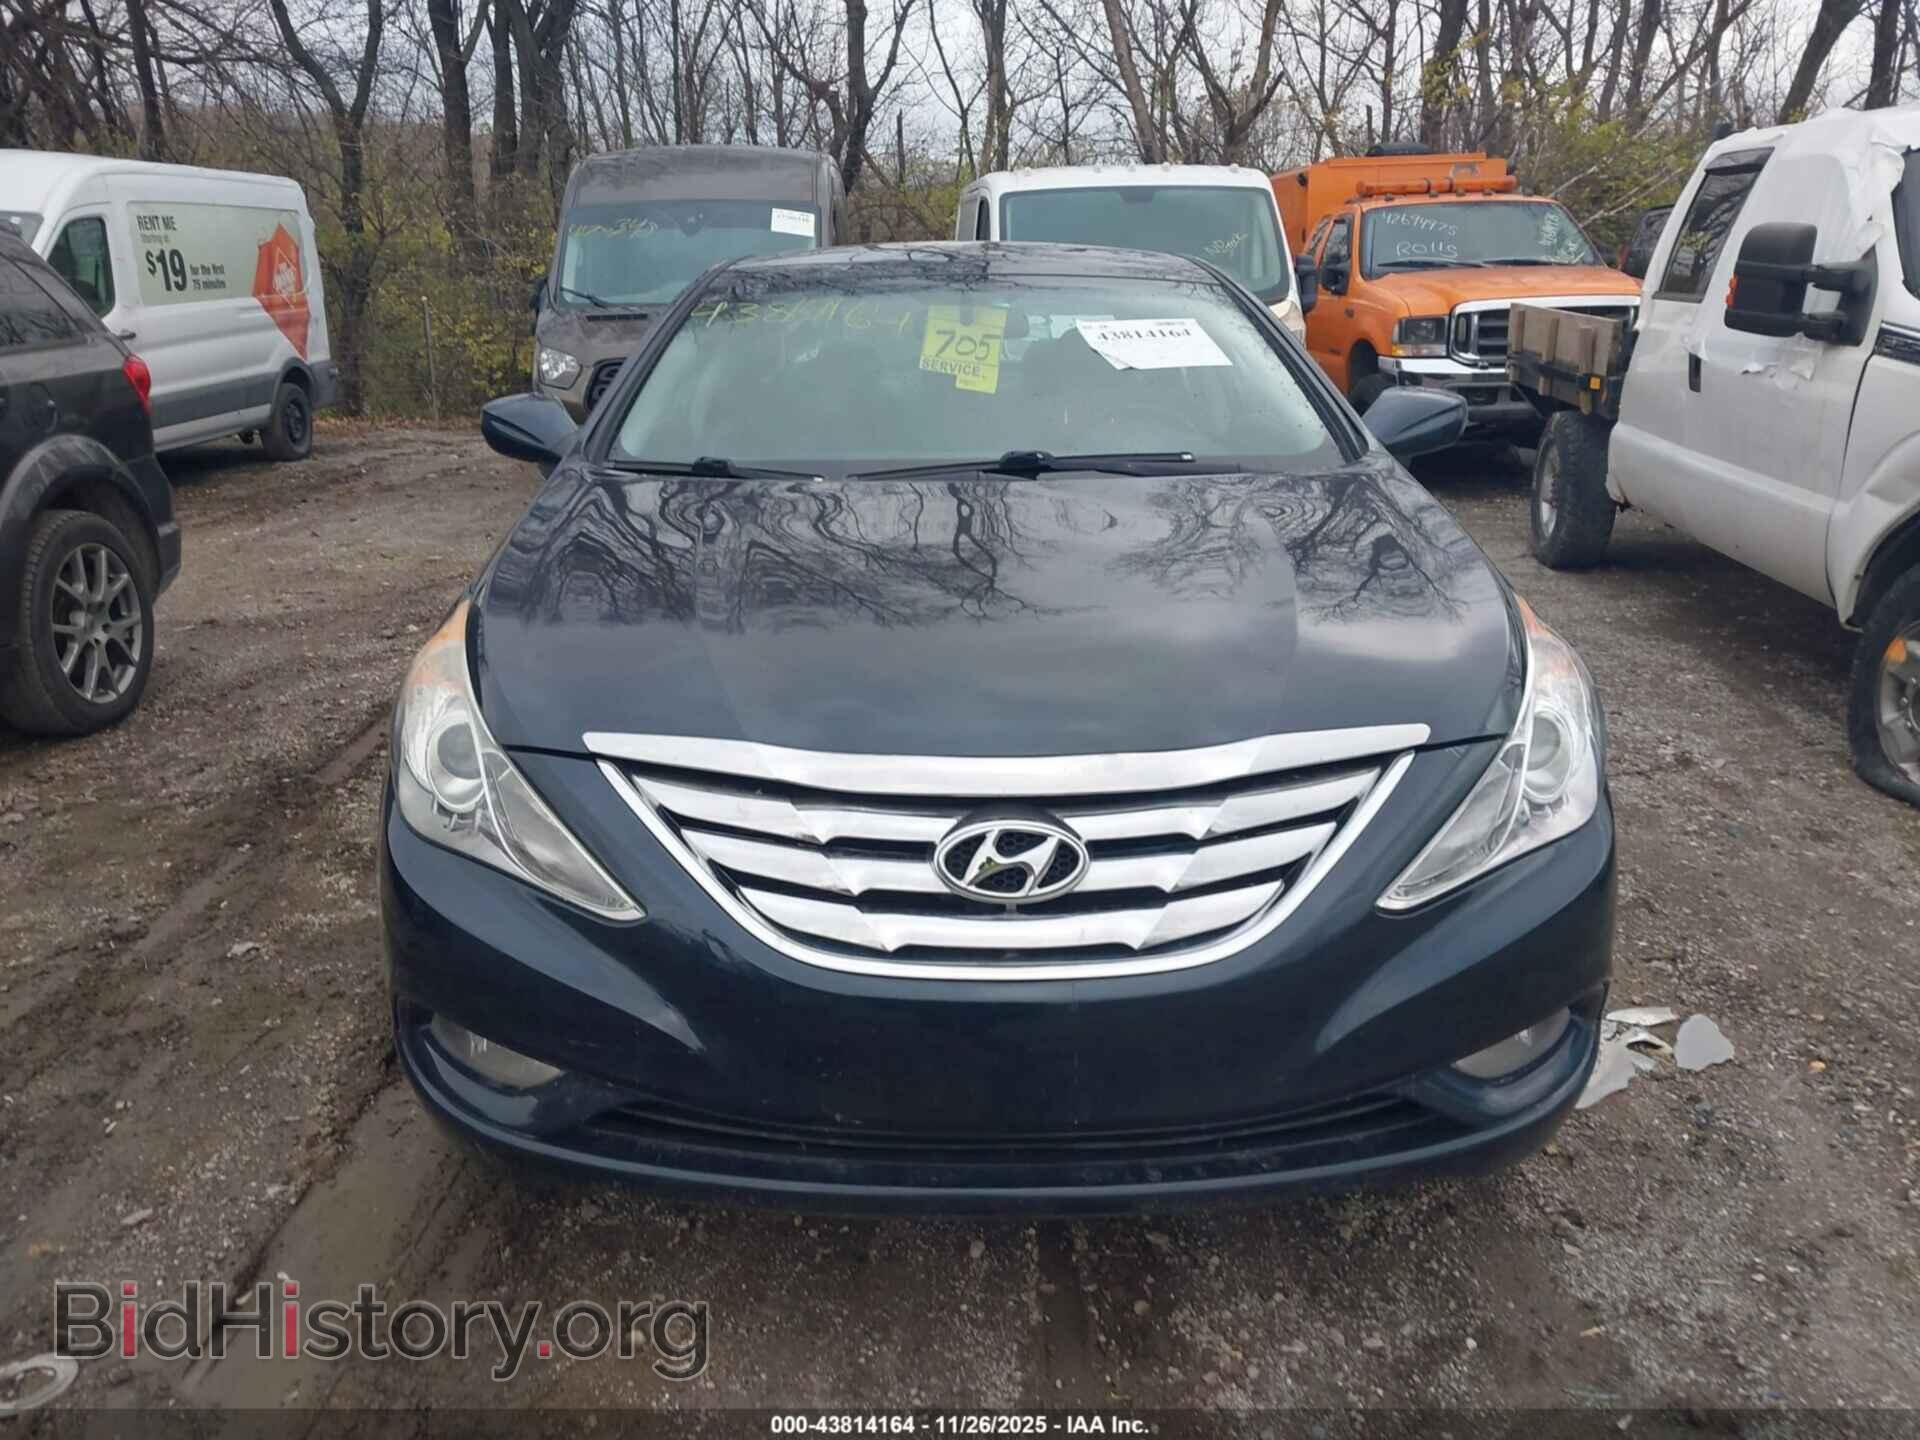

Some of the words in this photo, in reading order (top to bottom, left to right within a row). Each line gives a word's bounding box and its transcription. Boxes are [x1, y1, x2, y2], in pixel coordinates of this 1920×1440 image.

[136, 215, 161, 232] RENT
[161, 215, 177, 231] ME
[145, 248, 188, 292] $19
[190, 264, 199, 275] for
[200, 264, 211, 275] the
[192, 279, 201, 290] 75
[935, 329, 1001, 361] 705
